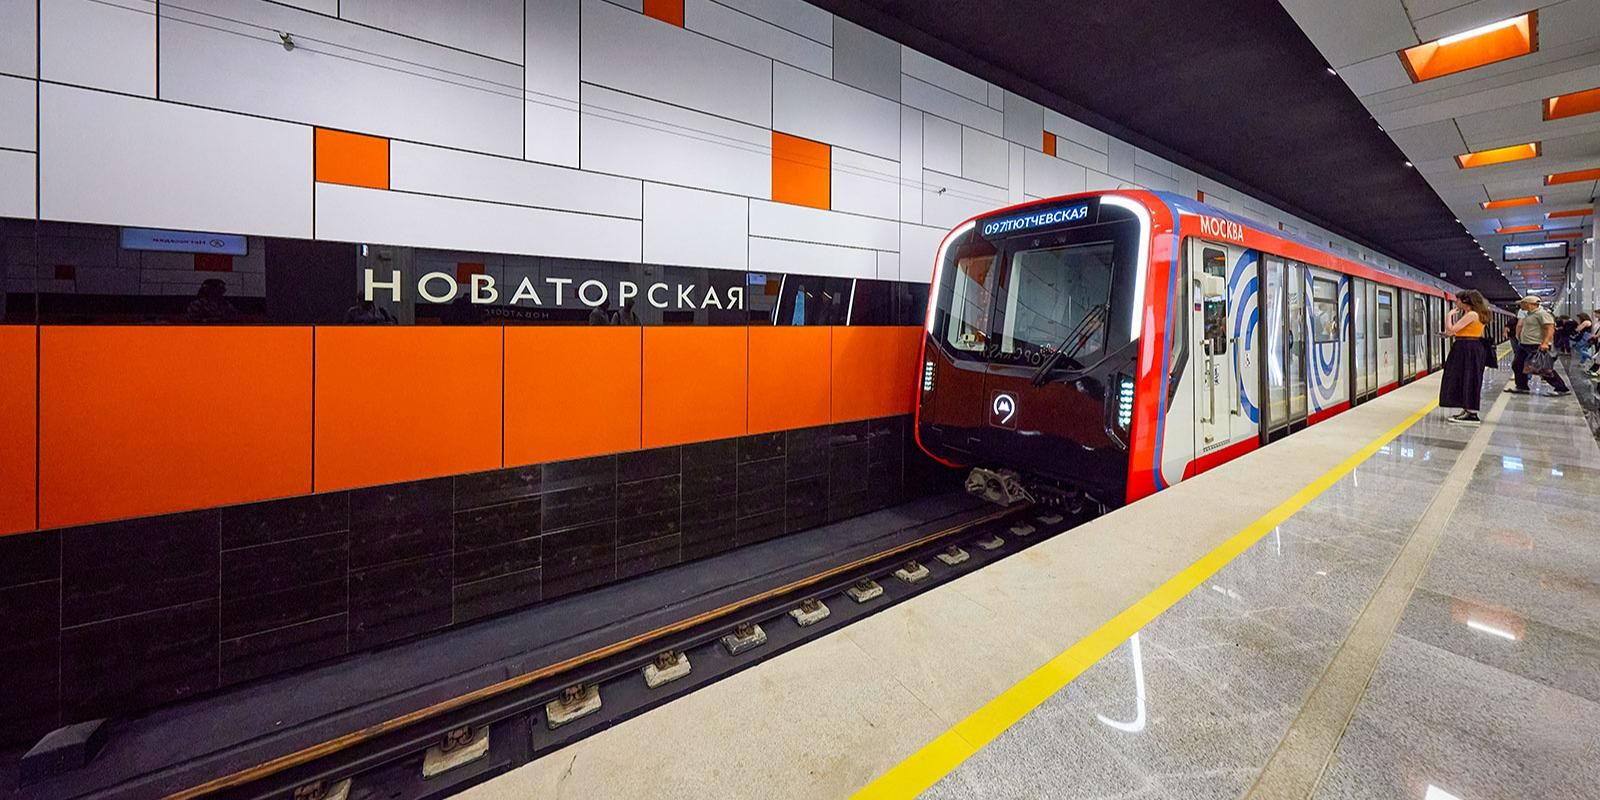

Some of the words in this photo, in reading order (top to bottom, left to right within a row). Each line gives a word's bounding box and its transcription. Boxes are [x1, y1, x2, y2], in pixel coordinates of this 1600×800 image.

[1008, 206, 1089, 231] ТЮТЧЕВСКАЯ
[1200, 215, 1244, 242] МОСКВА
[364, 269, 744, 310] НОВАТОРСКАЯ
